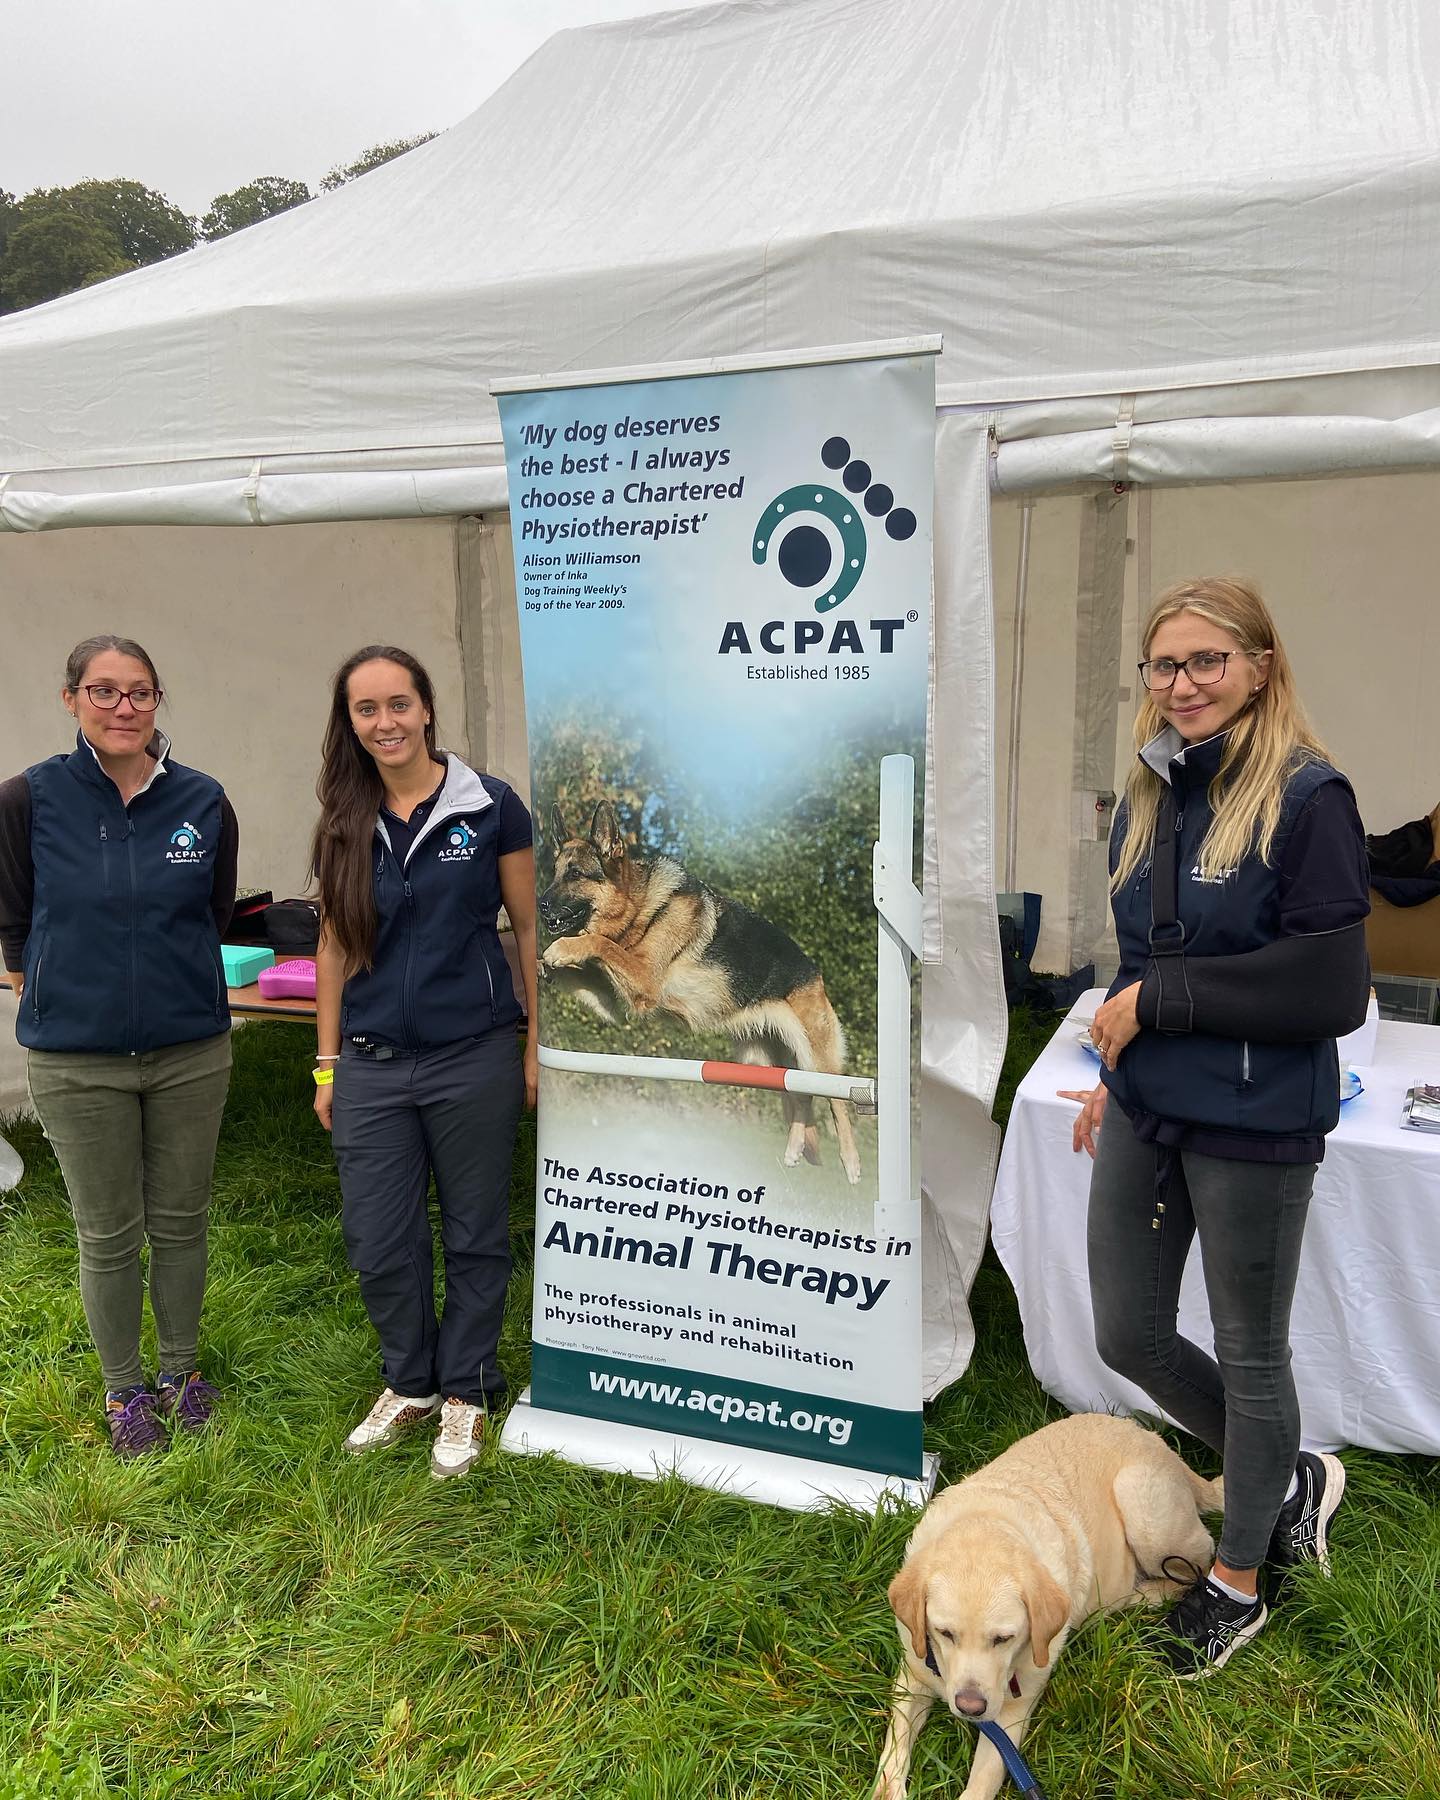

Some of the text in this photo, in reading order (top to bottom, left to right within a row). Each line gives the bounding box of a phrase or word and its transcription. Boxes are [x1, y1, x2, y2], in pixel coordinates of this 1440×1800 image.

[564, 419, 607, 446] dog
[614, 414, 721, 440] deserves
[520, 457, 553, 478] the
[561, 453, 610, 475] best
[630, 451, 638, 471] I
[646, 447, 731, 472] always
[520, 477, 745, 510] choose a Chartered
[523, 552, 641, 567] Alison Williamson
[523, 571, 588, 581] Owner of Inka
[524, 587, 541, 597] Dog
[543, 586, 581, 597] Training
[525, 599, 625, 612] Dog of the Year 2009.
[747, 665, 871, 681] Established 1985
[543, 1158, 766, 1205] The Association of
[543, 1187, 912, 1256] Chartered Physiotherapists in
[543, 1220, 891, 1312] Animal Therapy
[544, 1283, 797, 1339] The professionals in animal
[544, 1305, 854, 1372] physiotherapy and rehabilitation
[545, 1337, 577, 1348] Photograph
[582, 1343, 595, 1352] Tony
[589, 1371, 853, 1445] www.acpat.org
